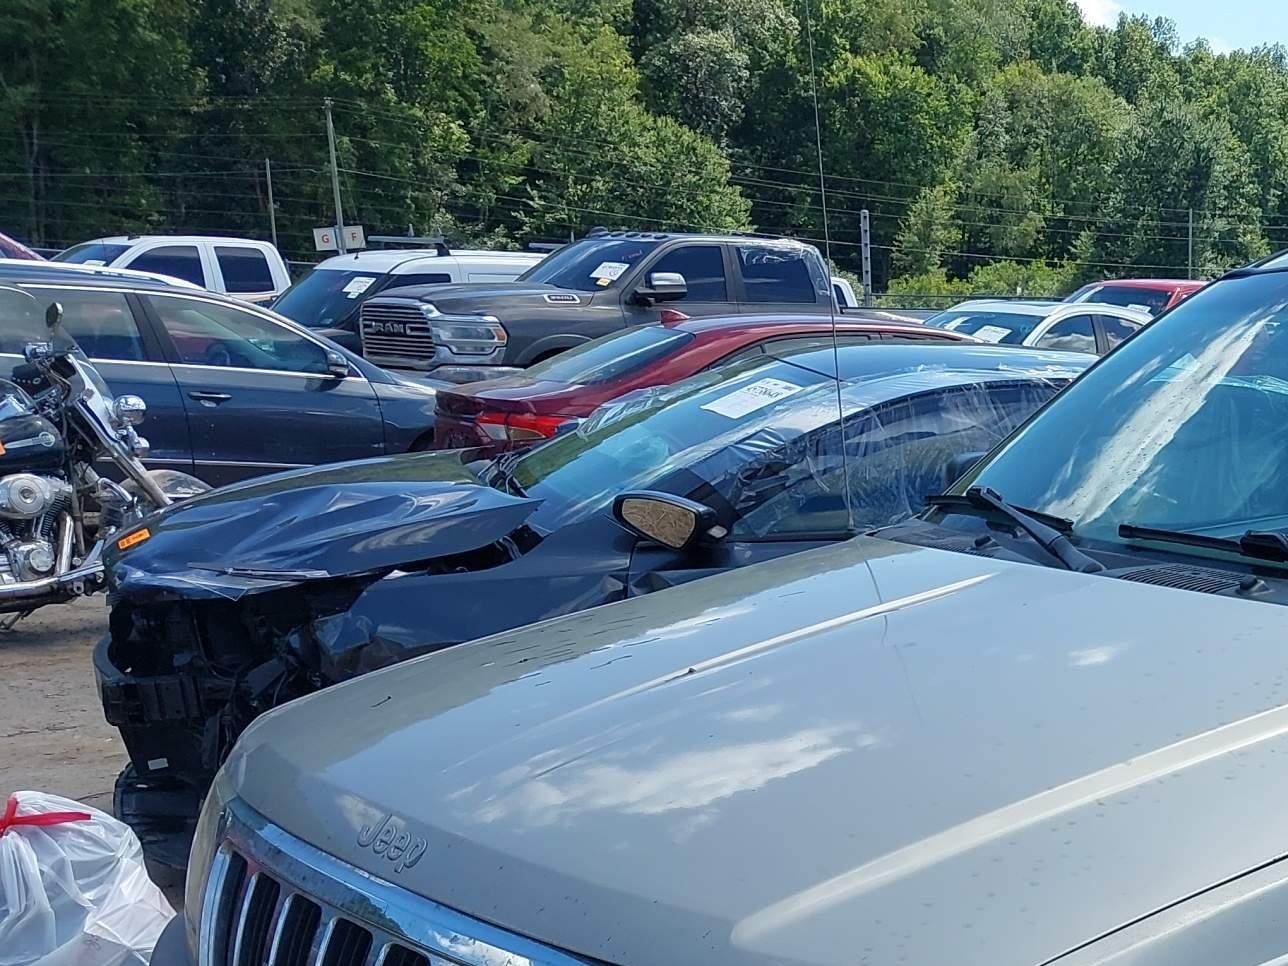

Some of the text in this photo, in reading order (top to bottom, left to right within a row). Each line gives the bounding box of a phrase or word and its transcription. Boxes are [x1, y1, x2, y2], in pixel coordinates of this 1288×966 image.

[321, 233, 330, 244] G
[351, 232, 358, 241] F
[374, 322, 405, 333] RAM
[356, 813, 429, 874] Jeep
